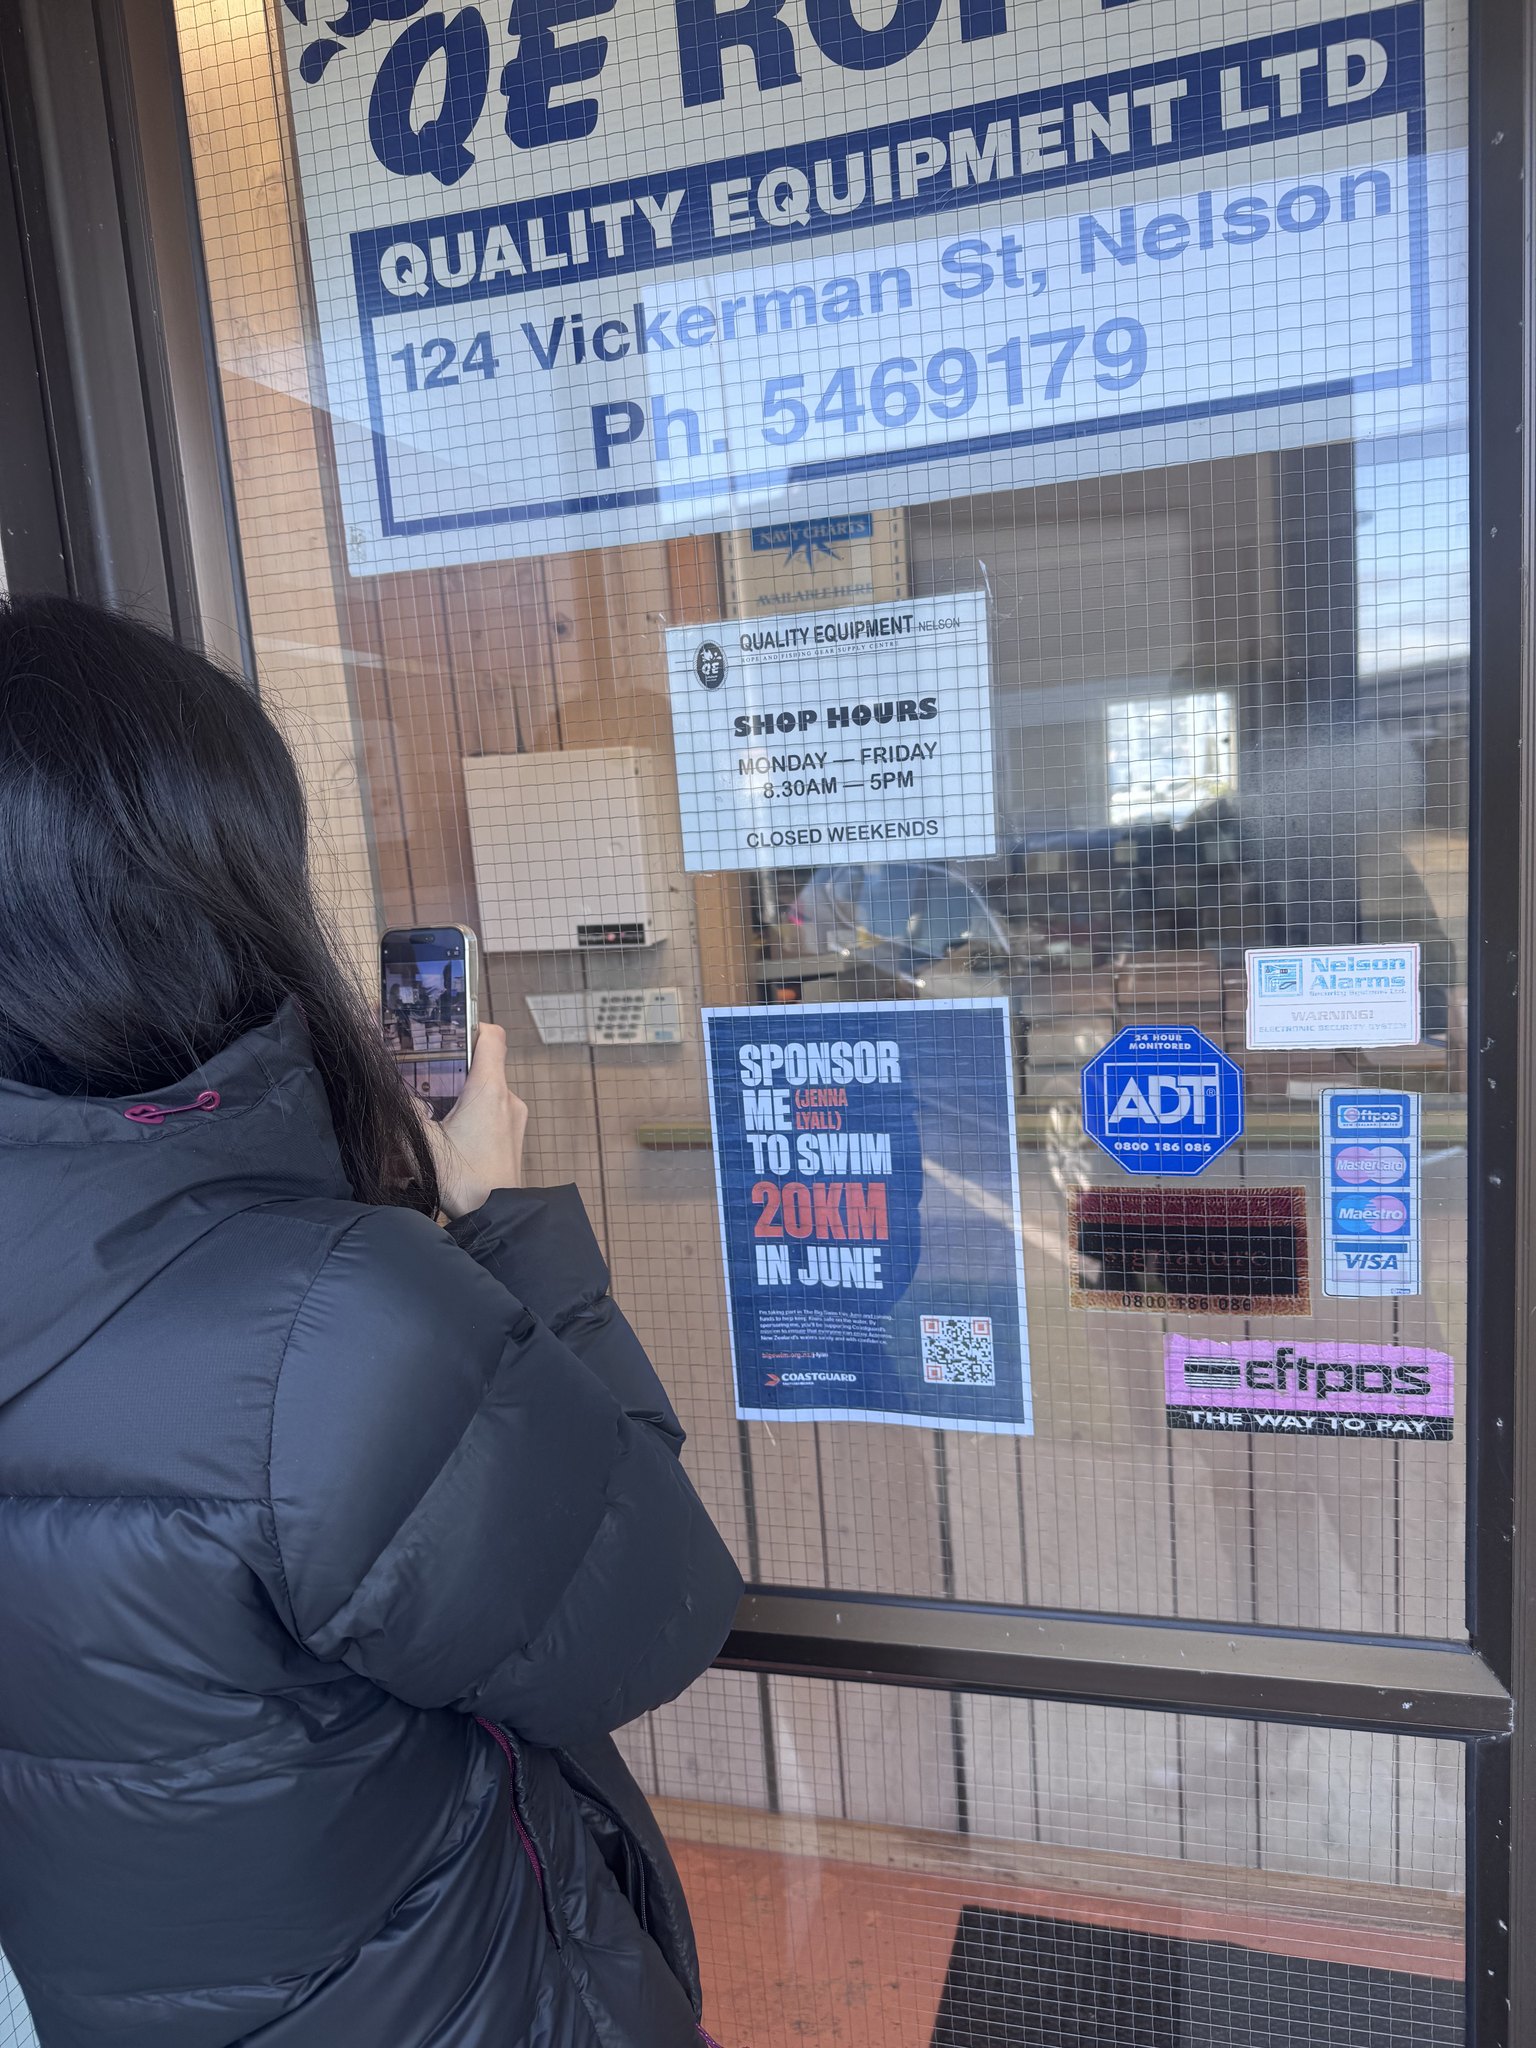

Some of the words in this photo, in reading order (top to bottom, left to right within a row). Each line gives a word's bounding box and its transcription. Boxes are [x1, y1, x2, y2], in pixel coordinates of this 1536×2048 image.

[368, 0, 618, 186] QE
[379, 189, 686, 297] QUALITY
[709, 80, 1187, 237] EQUIPMENT
[1219, 38, 1388, 132] LTD
[390, 331, 500, 393] 124
[520, 266, 913, 370] Vickerman
[941, 235, 1048, 297] St,
[1078, 170, 1392, 274] Nelson
[591, 395, 727, 470] Ph.
[762, 316, 1149, 445] 5469179
[760, 530, 799, 544] NAVY
[803, 520, 866, 539] CHARTS
[740, 627, 810, 651] QUALITY
[814, 615, 914, 644] EQUIPMENT
[918, 618, 961, 632] NELSON
[781, 651, 812, 659] FISHING
[734, 709, 817, 737] SHOP
[827, 697, 938, 729] HOURS
[738, 752, 828, 776] MONDAY
[860, 742, 938, 765] FRIDAY
[763, 776, 837, 799] 8.30AM
[870, 770, 914, 791] 5PM
[746, 828, 822, 848] CLOSED
[827, 820, 938, 843] WEEKENDS
[1310, 957, 1406, 973] Nelson
[1310, 974, 1406, 990] Alarms
[1291, 1009, 1374, 1022] WARNING!
[1134, 1034, 1149, 1042] 24
[1152, 1034, 1183, 1042] HOUR
[1259, 1025, 1315, 1033] ELECTRONIC
[1318, 1024, 1365, 1032] SECURITY
[1129, 1042, 1192, 1050] MONITORED
[738, 1040, 902, 1087] SPONSOR
[795, 1087, 848, 1109] (JENNA
[1108, 1075, 1218, 1125] ADT
[743, 1089, 792, 1132] ME
[795, 1110, 842, 1131] LYALL)
[747, 1133, 791, 1175] TO
[797, 1132, 893, 1176] SWIM
[1114, 1141, 1149, 1151] 0800
[1154, 1142, 1180, 1152] 186
[1184, 1142, 1212, 1152] 086
[1336, 1159, 1405, 1172] MasterCard
[751, 1181, 889, 1241] 20KM
[1338, 1207, 1404, 1220] Maestro
[755, 1244, 791, 1287] IN
[797, 1245, 884, 1289] JUNE
[1104, 1247, 1268, 1272] signature
[1344, 1253, 1398, 1270] VISA
[1122, 1294, 1167, 1308] 0800
[1218, 1296, 1252, 1311] 086
[781, 1373, 857, 1382] COASTGUARD
[1245, 1347, 1431, 1400] eftpos
[1187, 1410, 1243, 1426] THE
[1253, 1413, 1317, 1428] WAY
[1323, 1417, 1365, 1431] TO
[1376, 1419, 1430, 1434] PAY
